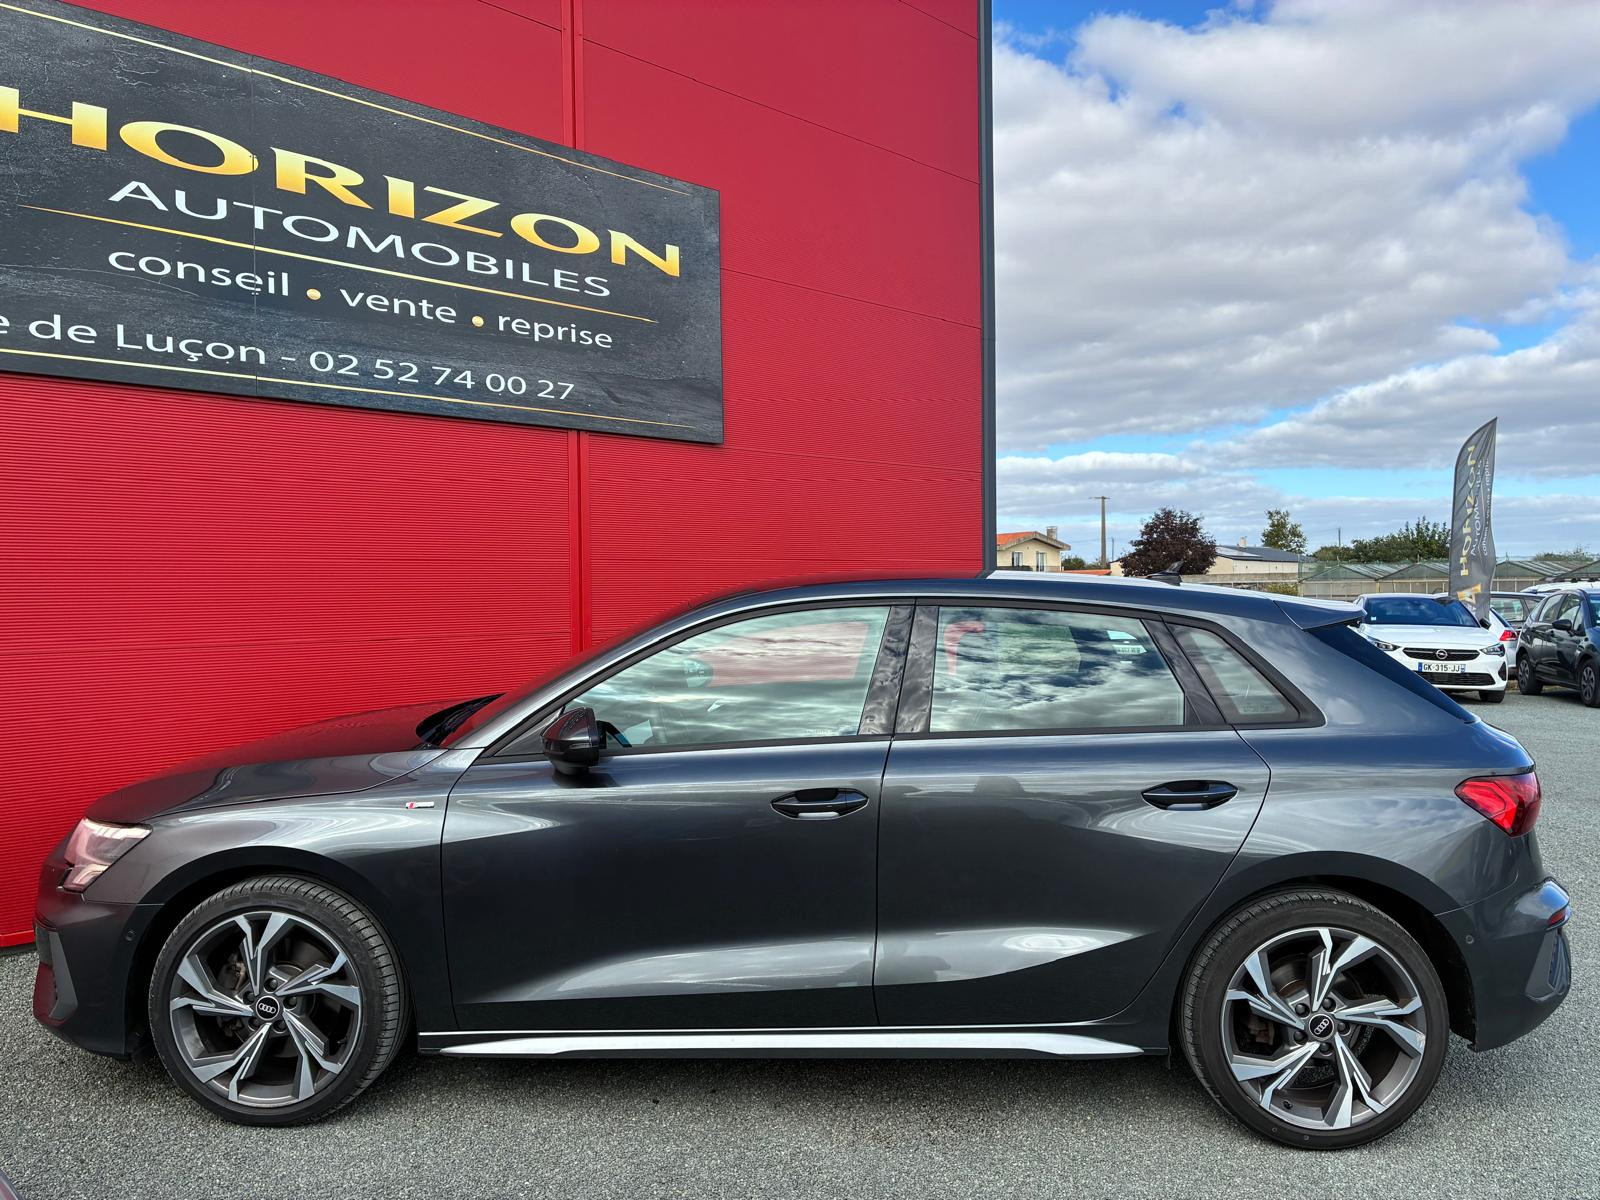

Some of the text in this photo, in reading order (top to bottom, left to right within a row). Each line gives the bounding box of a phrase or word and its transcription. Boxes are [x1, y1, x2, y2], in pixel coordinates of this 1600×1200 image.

[0, 85, 680, 278] HORIZON
[107, 180, 611, 297] AUTOMOBILES
[107, 251, 614, 348] conseil vente reprise
[28, 313, 98, 344] de
[116, 323, 266, 364] Luçon
[309, 351, 360, 376] 02
[373, 359, 419, 383] 52
[431, 366, 476, 390] 74
[485, 374, 527, 395] 00
[536, 380, 575, 400] 27
